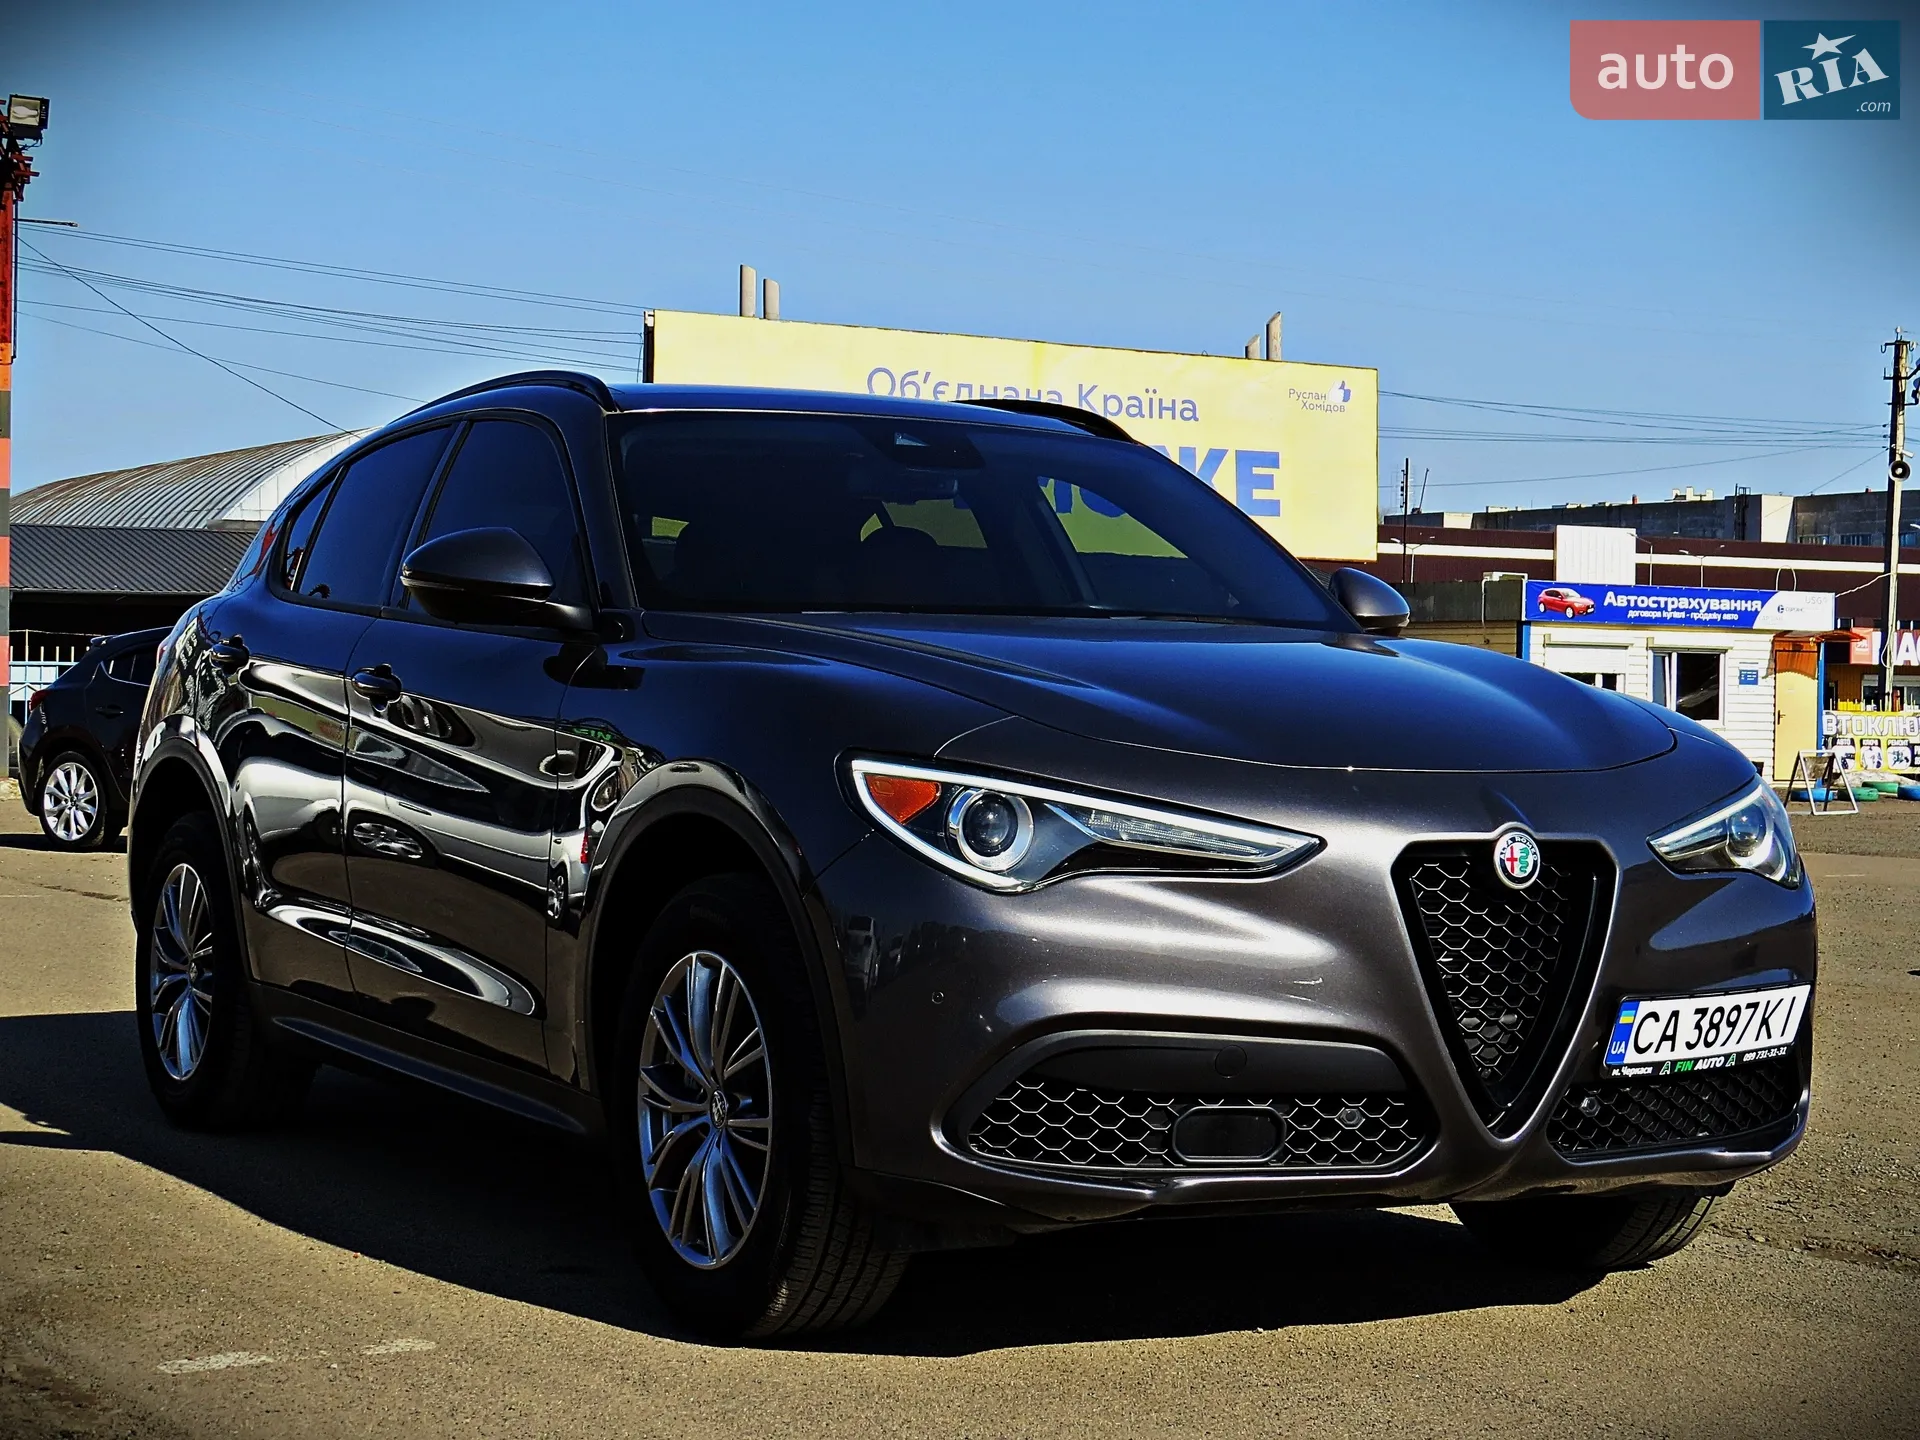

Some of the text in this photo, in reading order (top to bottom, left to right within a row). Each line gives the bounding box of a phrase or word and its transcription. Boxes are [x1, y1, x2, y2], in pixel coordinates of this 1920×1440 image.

[1288, 388, 1327, 401] Руслан
[1078, 383, 1199, 422] Країна
[1301, 400, 1346, 413] Хомідов
[1603, 591, 1762, 612] Автострахування
[1627, 610, 1662, 619] договора
[1722, 613, 1739, 621] авто
[1633, 1010, 1680, 1054] CA
[1611, 1040, 1626, 1055] UA
[1674, 1060, 1694, 1072] FIN
[1694, 1056, 1725, 1070] AUTO
